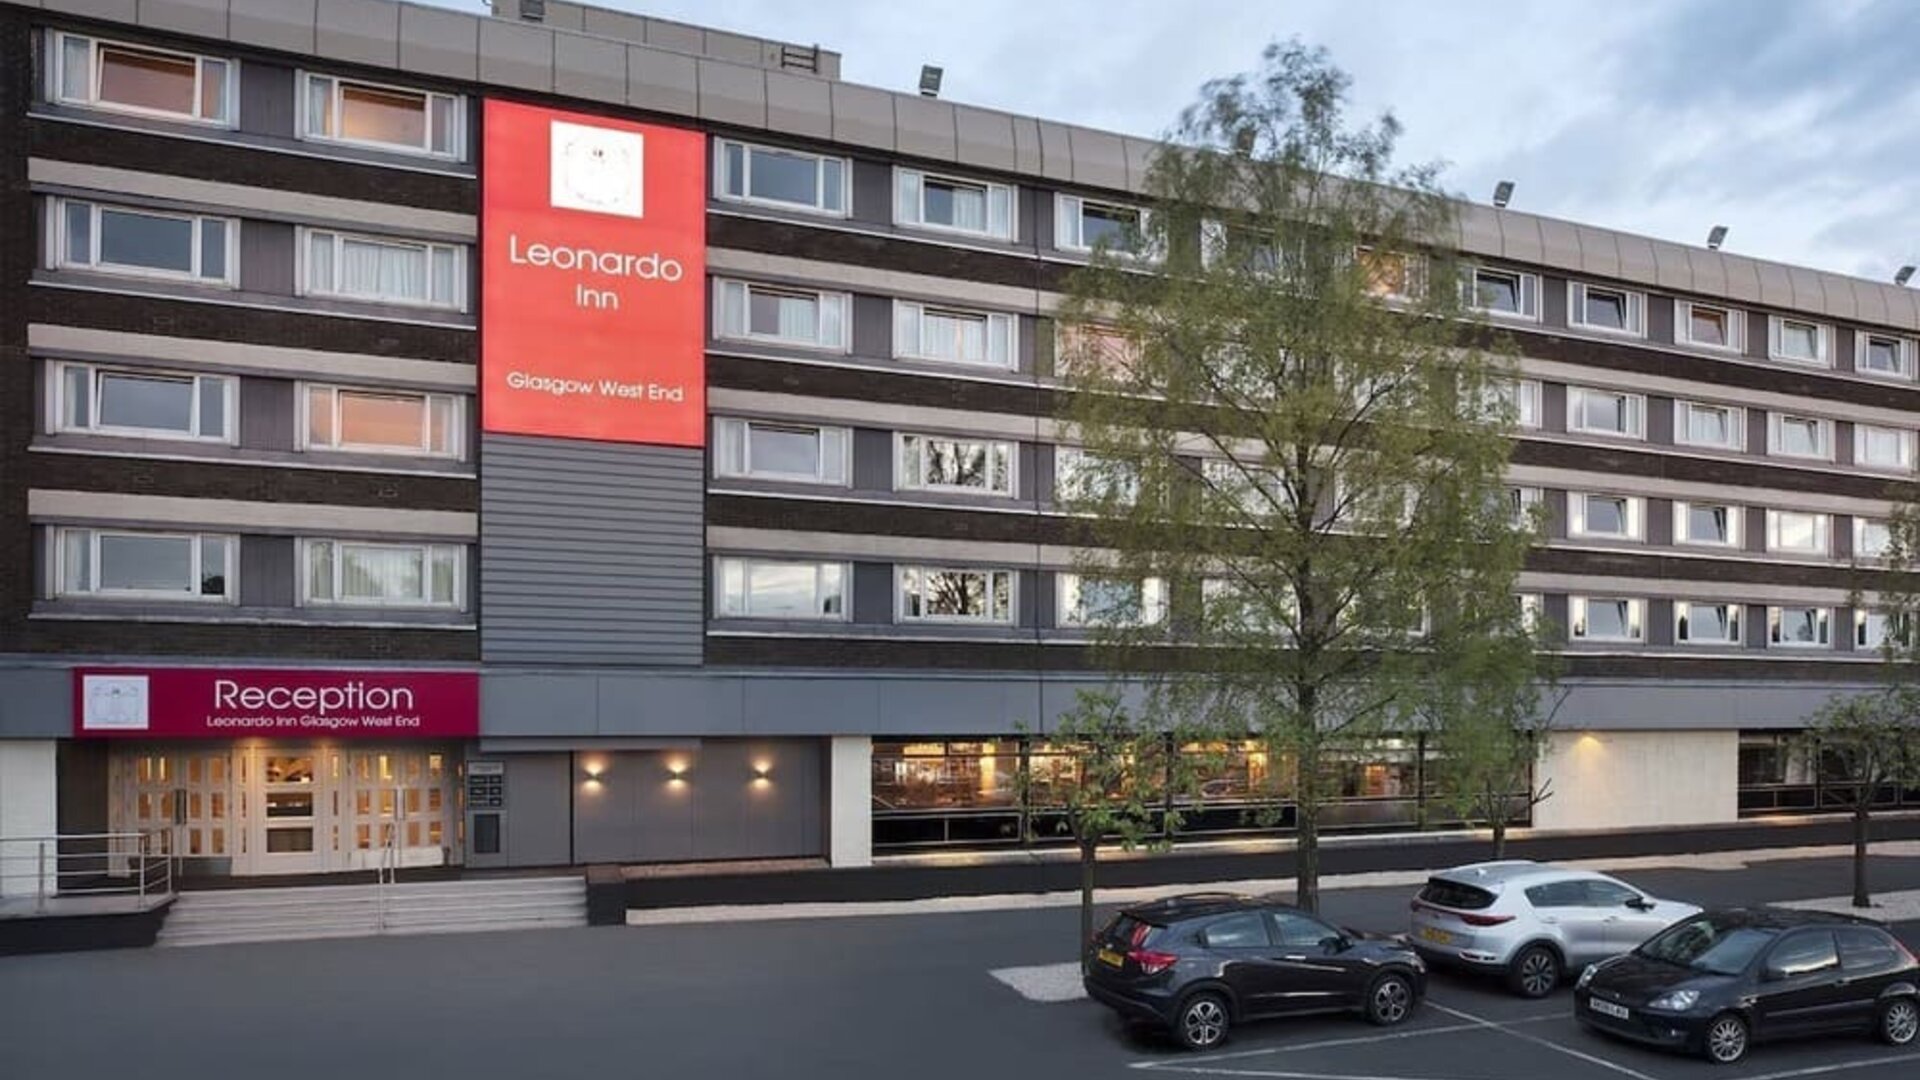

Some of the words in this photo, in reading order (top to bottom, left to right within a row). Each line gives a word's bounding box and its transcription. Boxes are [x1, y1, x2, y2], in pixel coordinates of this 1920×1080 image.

[509, 235, 683, 282] Leonardo
[576, 284, 619, 310] Inn
[507, 372, 593, 396] Glasgow
[598, 378, 643, 399] West
[648, 384, 683, 402] End
[214, 680, 414, 714] Reception
[206, 715, 275, 728] Leonardo
[276, 715, 298, 728] Inn
[301, 715, 359, 731] Glasgow
[361, 715, 393, 728] West
[395, 715, 420, 728] End
